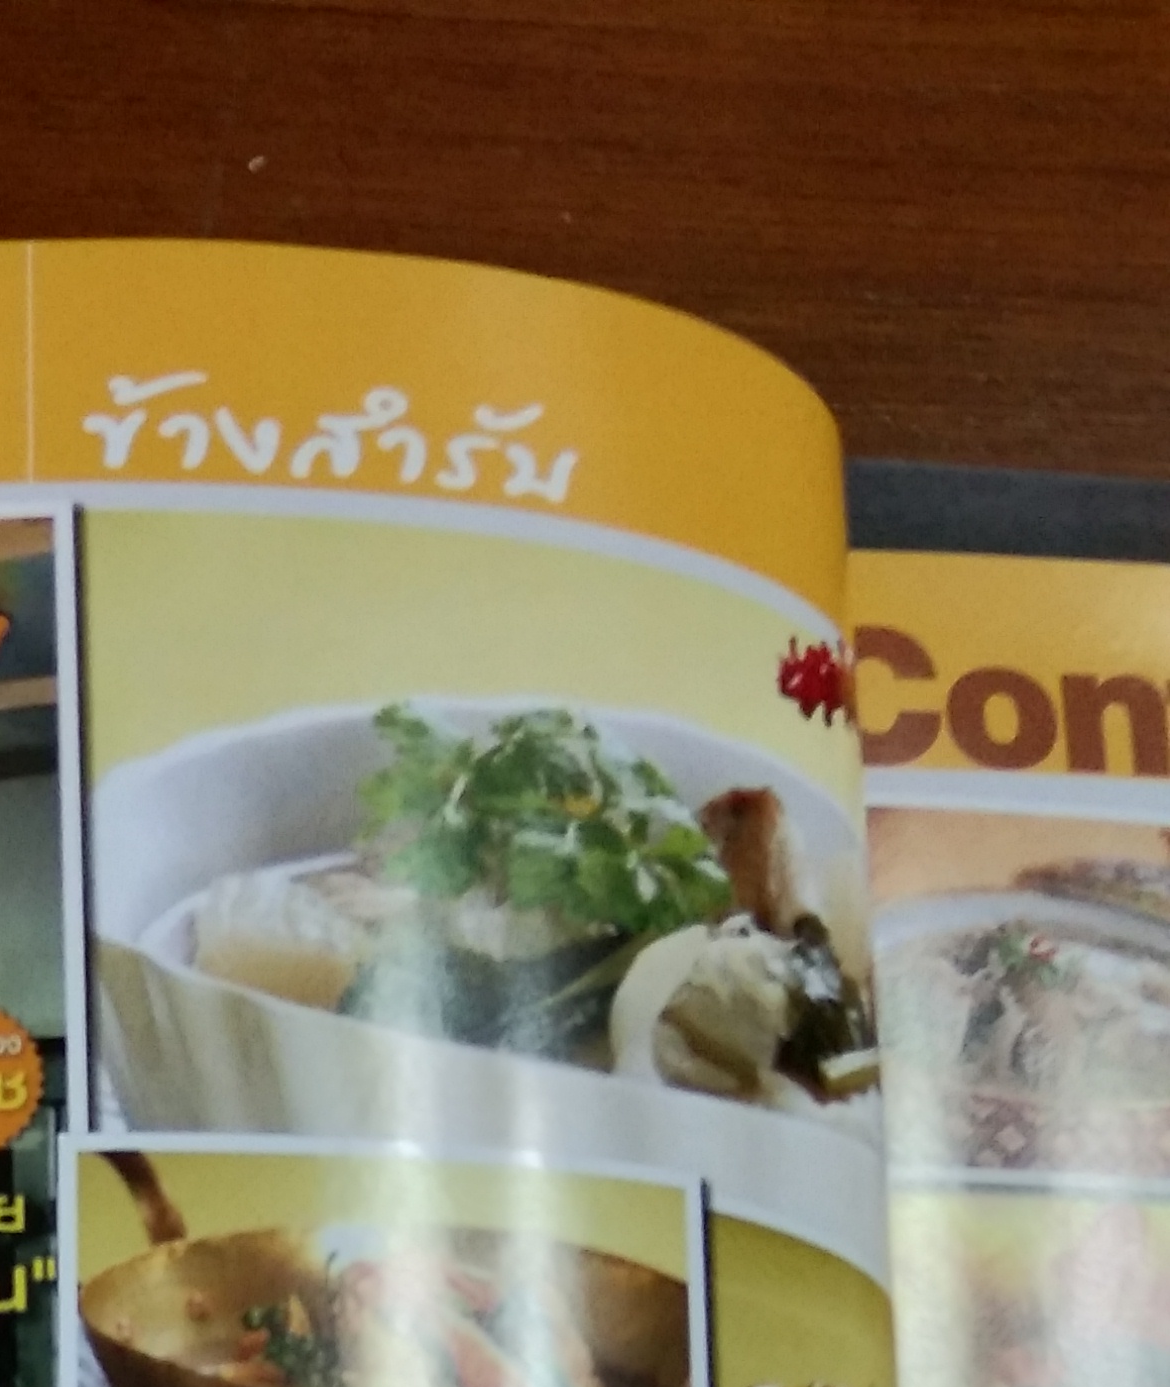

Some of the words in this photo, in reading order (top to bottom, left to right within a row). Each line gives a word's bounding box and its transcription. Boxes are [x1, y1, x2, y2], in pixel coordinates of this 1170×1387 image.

[82, 369, 578, 503] ข้างสำรับ
[854, 625, 1170, 775] Con
